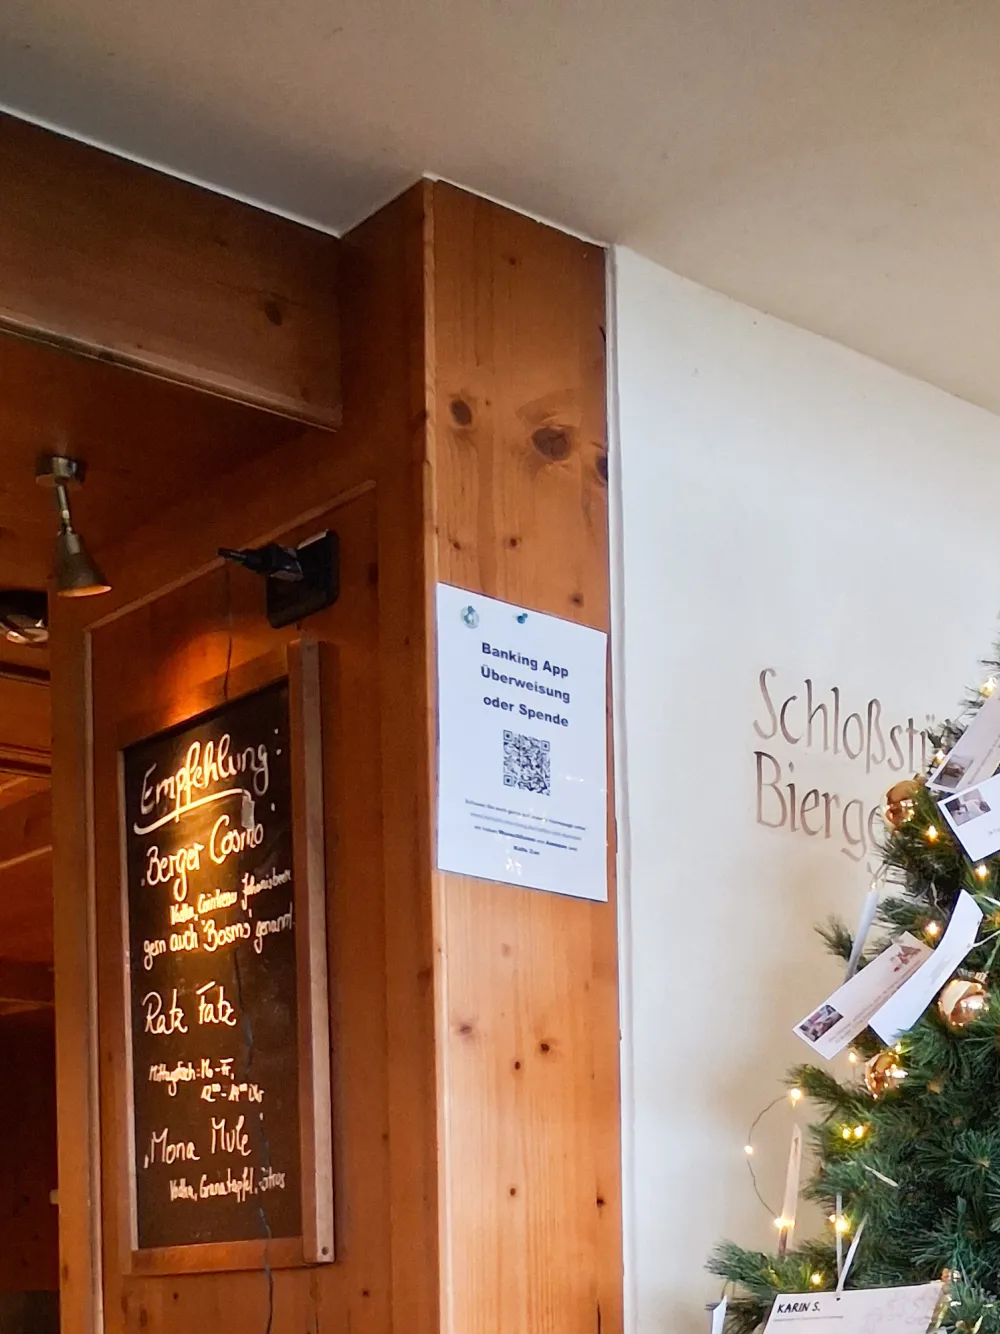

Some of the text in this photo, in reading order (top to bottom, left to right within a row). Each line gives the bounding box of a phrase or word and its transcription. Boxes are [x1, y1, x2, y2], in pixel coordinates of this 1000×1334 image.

[481, 642, 569, 679] Banking App
[481, 664, 571, 704] Überweisung
[483, 696, 569, 727] oder Spende
[170, 924, 198, 952] auch
[142, 981, 236, 1035] Ratz Fatz
[777, 1301, 821, 1314] KARIN S.
